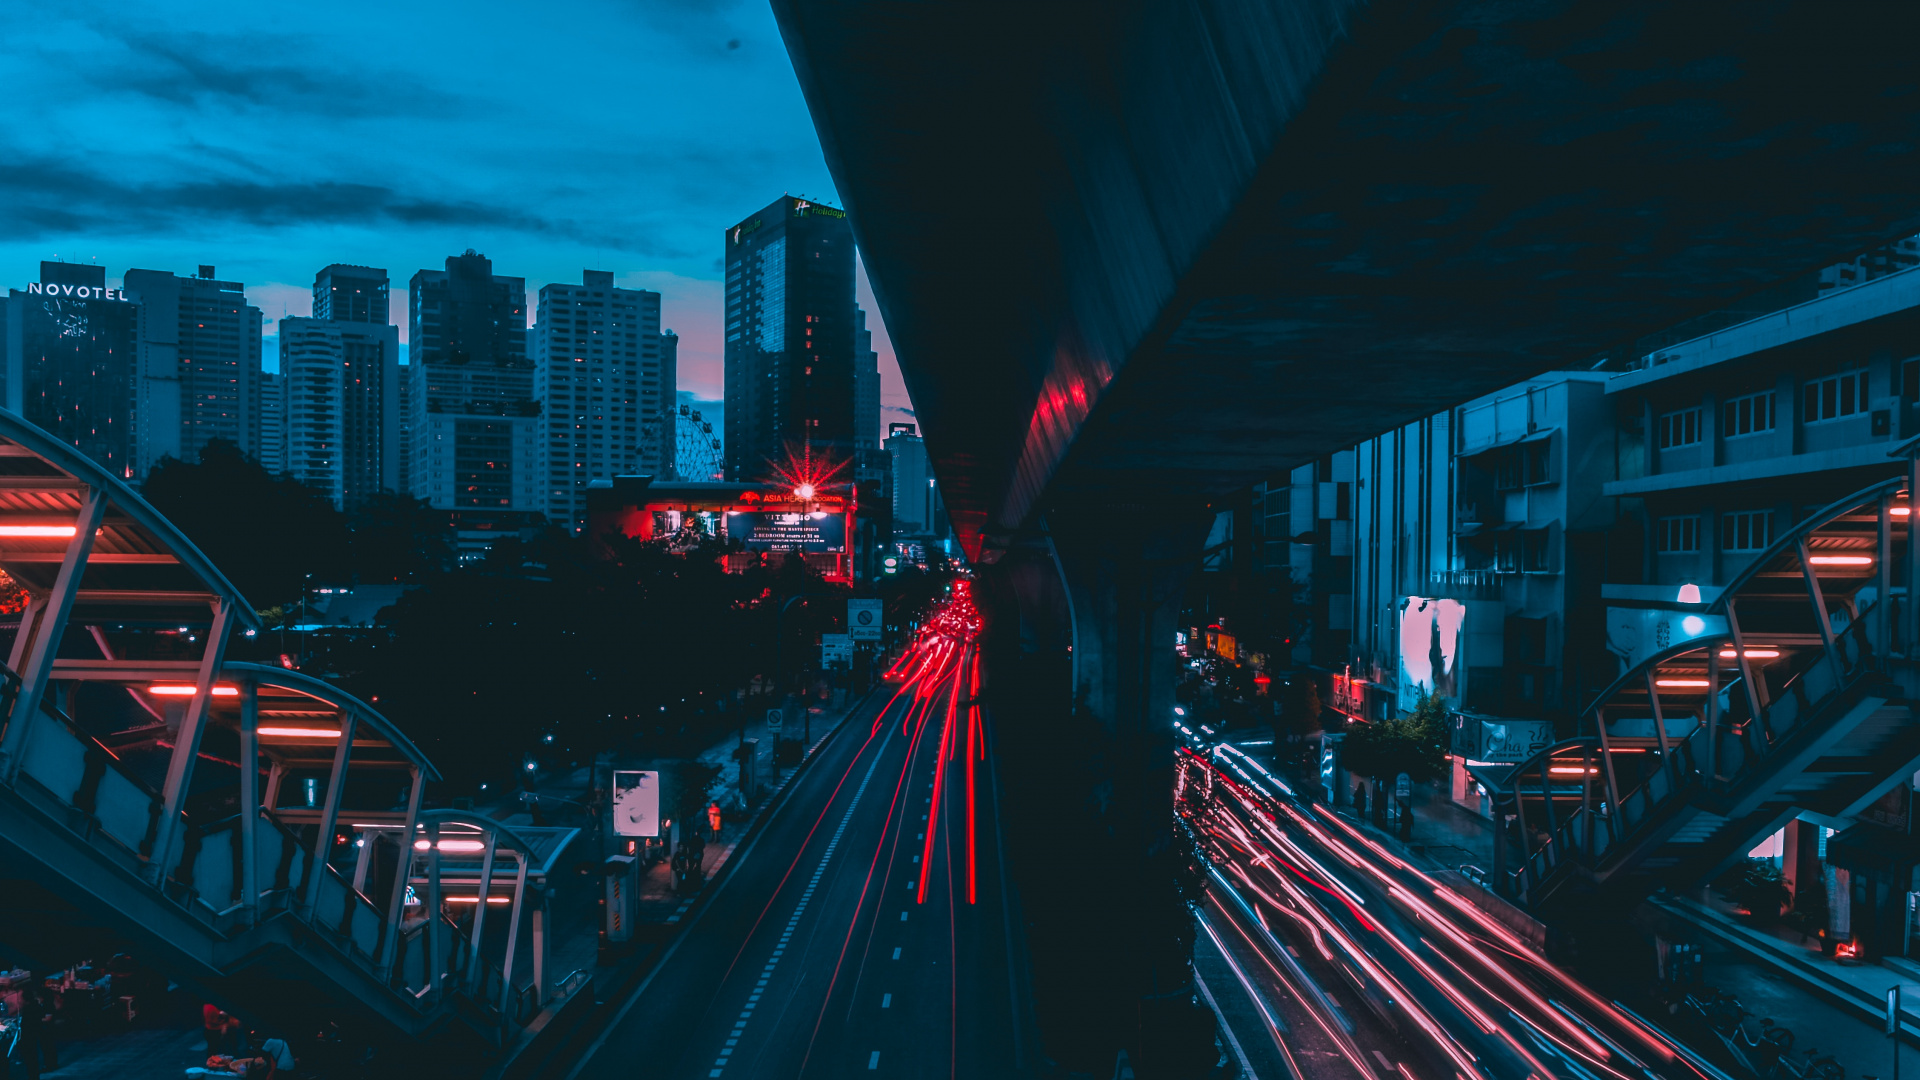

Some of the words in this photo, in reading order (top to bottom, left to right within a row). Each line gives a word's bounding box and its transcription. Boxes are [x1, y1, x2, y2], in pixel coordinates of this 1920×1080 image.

[812, 205, 843, 218] Holiday
[28, 282, 128, 302] NOVOTEL
[1486, 732, 1523, 752] Cha
